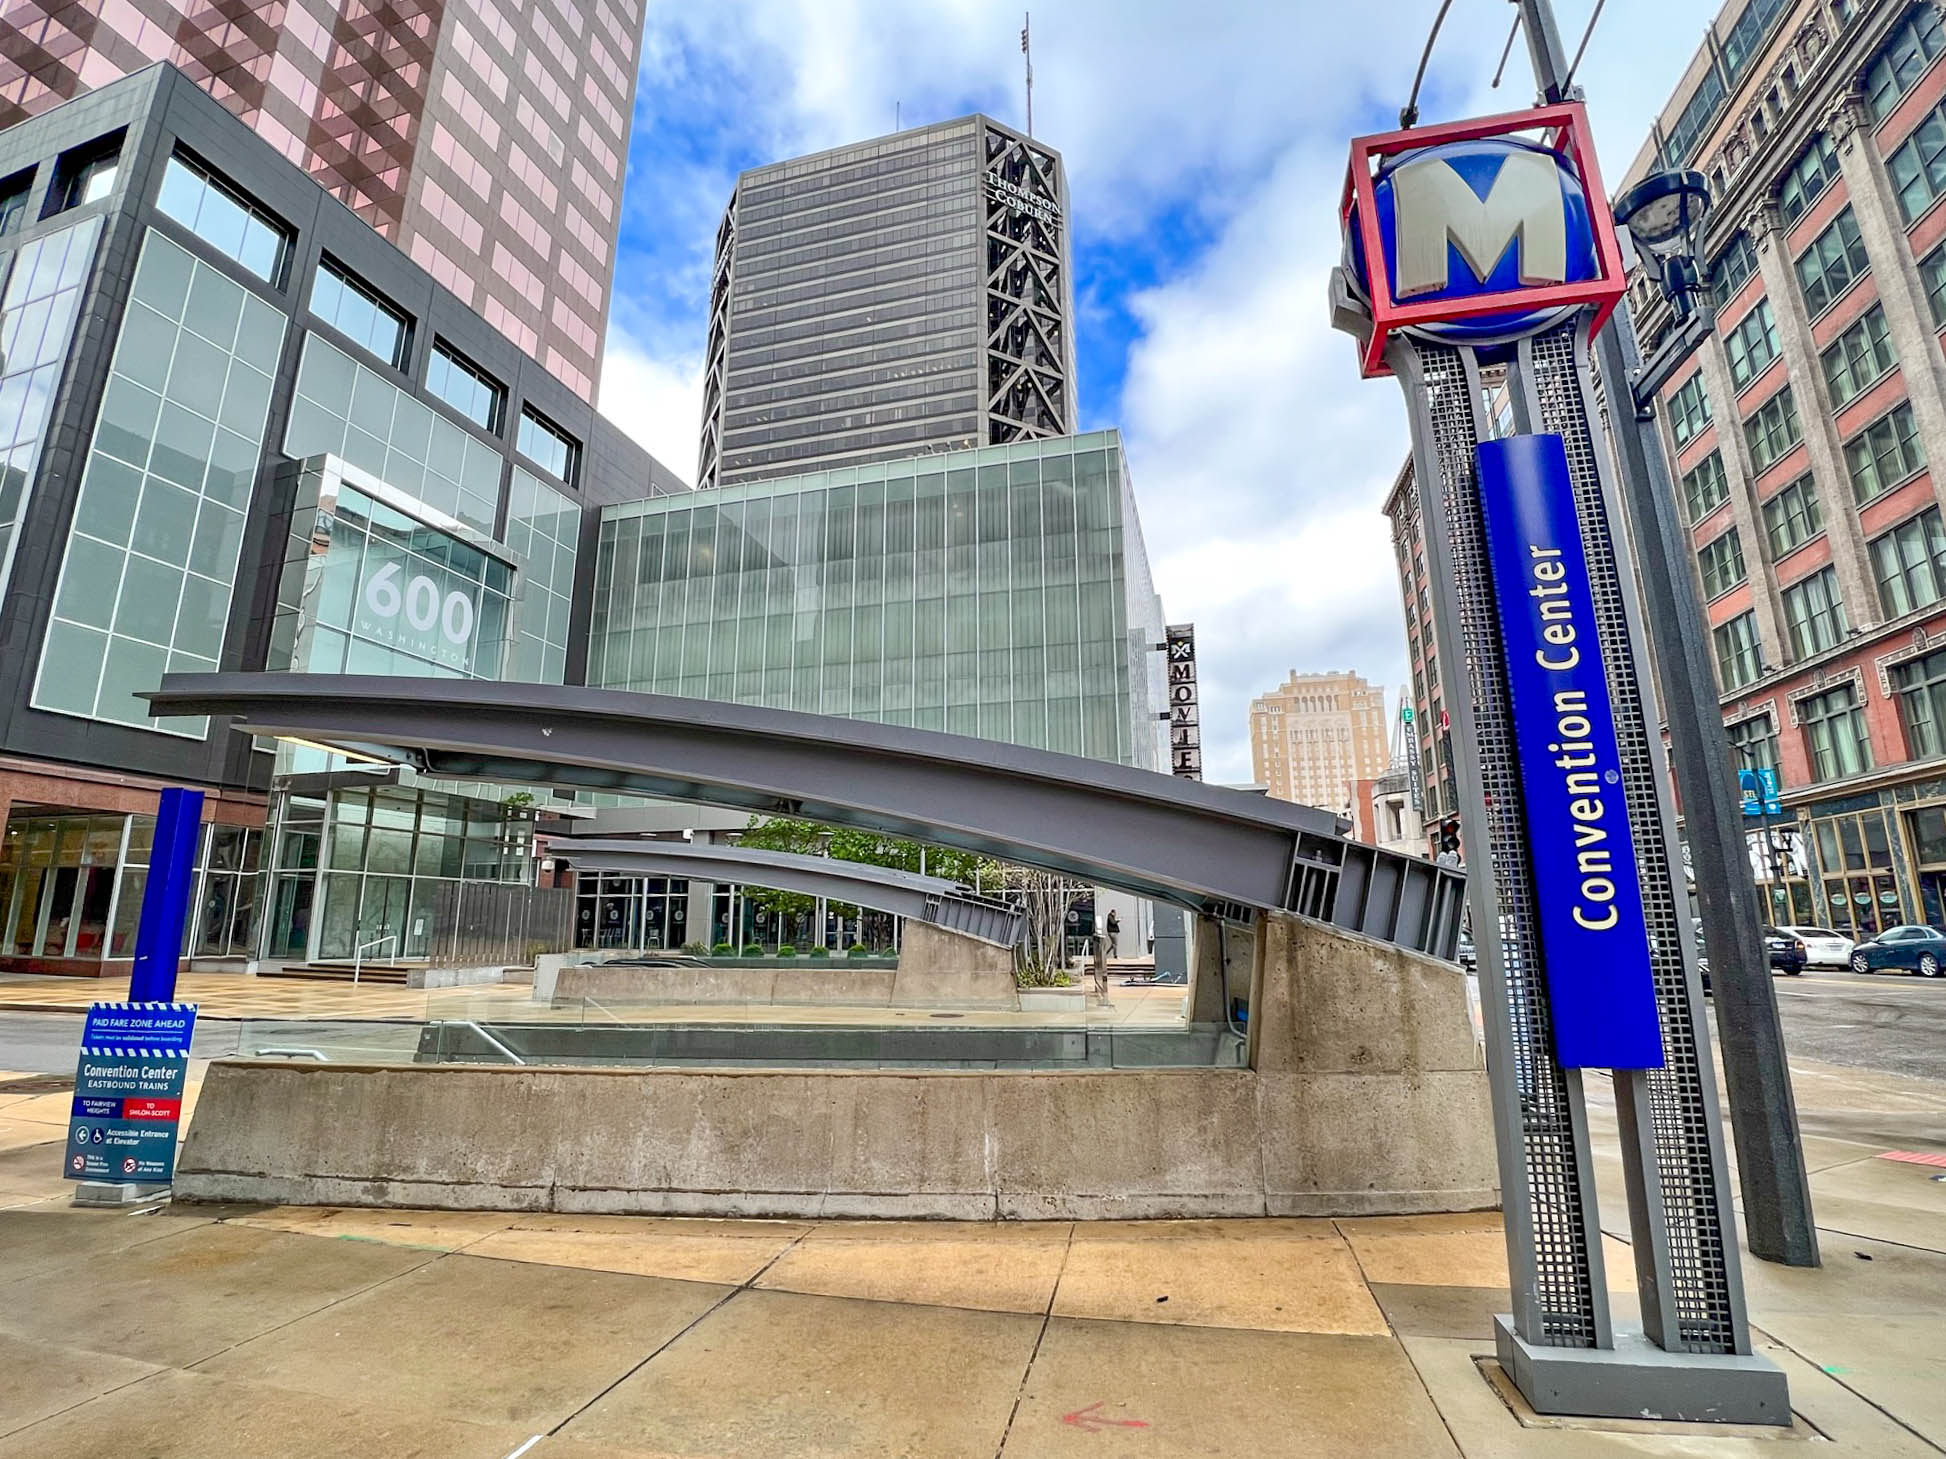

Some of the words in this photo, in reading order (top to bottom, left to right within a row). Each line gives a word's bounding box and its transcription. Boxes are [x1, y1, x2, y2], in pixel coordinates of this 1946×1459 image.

[985, 170, 1061, 214] THOMPSON
[995, 191, 1053, 224] COBURN
[1392, 151, 1566, 299] M
[366, 562, 474, 645] 600
[1529, 544, 1581, 671] Center
[360, 620, 470, 667] WASHINGTON
[1406, 726, 1416, 766] EMBASSY
[1548, 690, 1619, 931] Convention
[92, 1018, 109, 1026] PAID
[109, 1019, 129, 1027] FARE
[129, 1019, 153, 1028] ZONE
[154, 1020, 185, 1028] AHEAD
[84, 1064, 138, 1078] Convention
[141, 1065, 178, 1079] Center
[88, 1080, 136, 1089] EASTBOUND
[139, 1081, 169, 1090] TRAINS
[87, 1107, 110, 1115] HEIGHTS
[91, 1100, 116, 1108] FAIRVIEW
[106, 1129, 138, 1137] Accessible
[140, 1130, 169, 1138] Entrance
